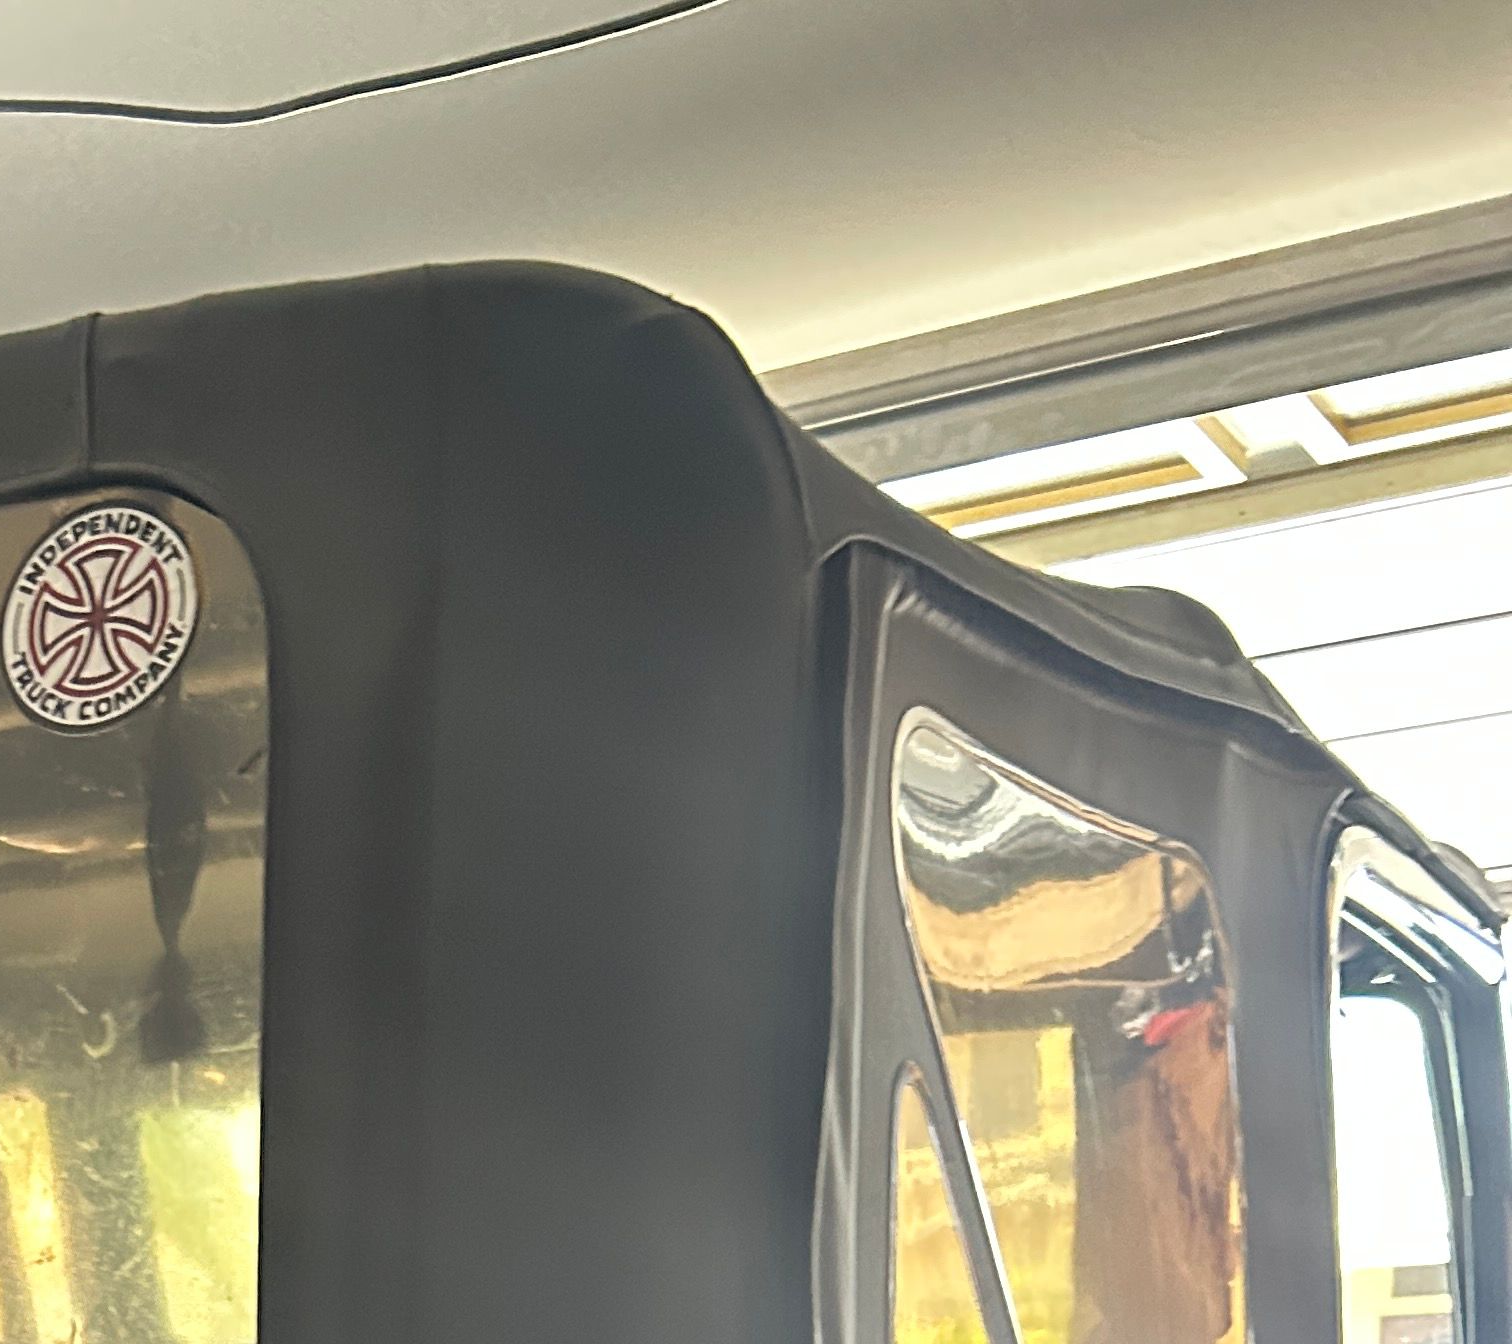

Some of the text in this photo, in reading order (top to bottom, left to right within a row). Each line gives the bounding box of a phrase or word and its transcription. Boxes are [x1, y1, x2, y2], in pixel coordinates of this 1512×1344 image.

[18, 513, 183, 595] INDEPENDENT
[12, 622, 184, 721] TRUCK COMPANY
